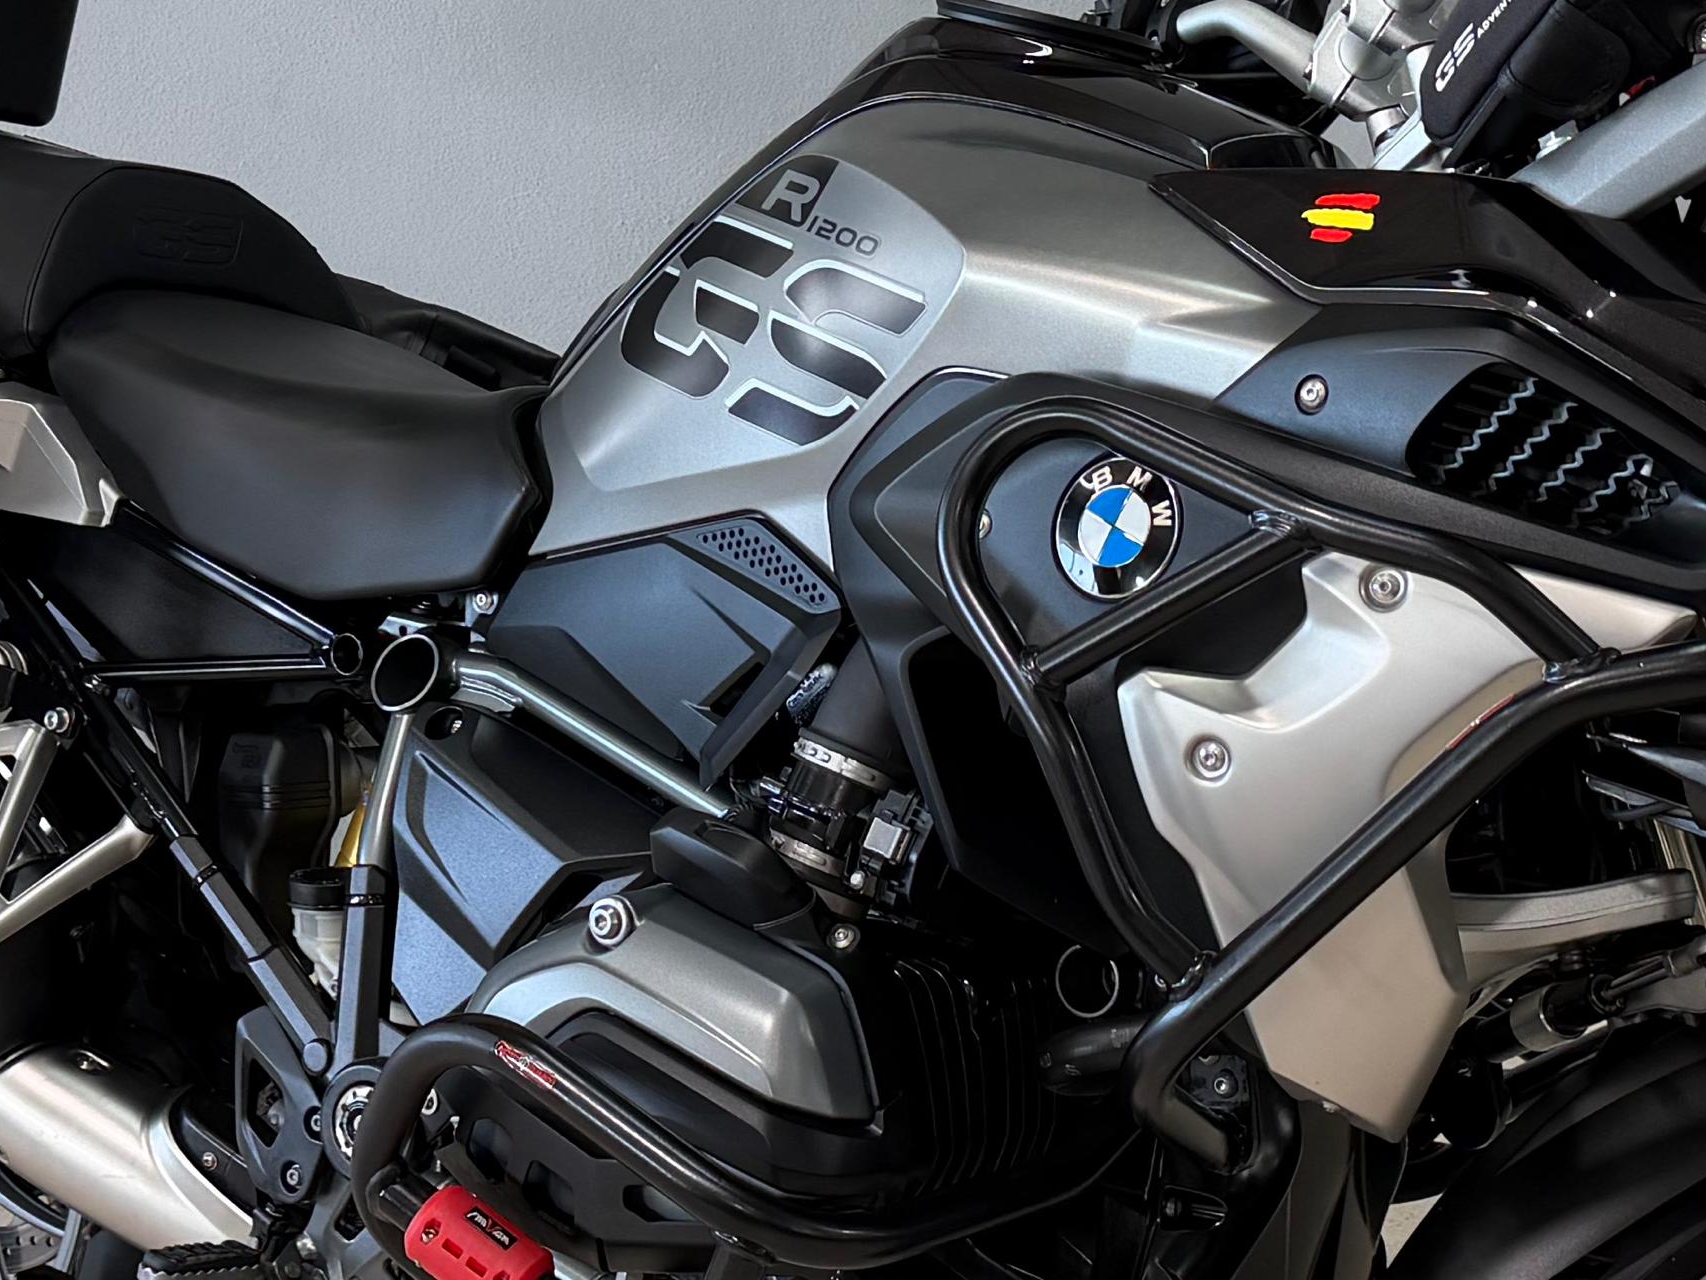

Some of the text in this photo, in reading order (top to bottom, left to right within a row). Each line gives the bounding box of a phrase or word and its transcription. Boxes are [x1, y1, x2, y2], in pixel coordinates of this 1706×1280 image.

[1435, 22, 1475, 92] GS
[761, 169, 821, 222] R
[804, 215, 881, 257] 1200
[620, 215, 927, 446] GS
[1089, 465, 1173, 526] BMW
